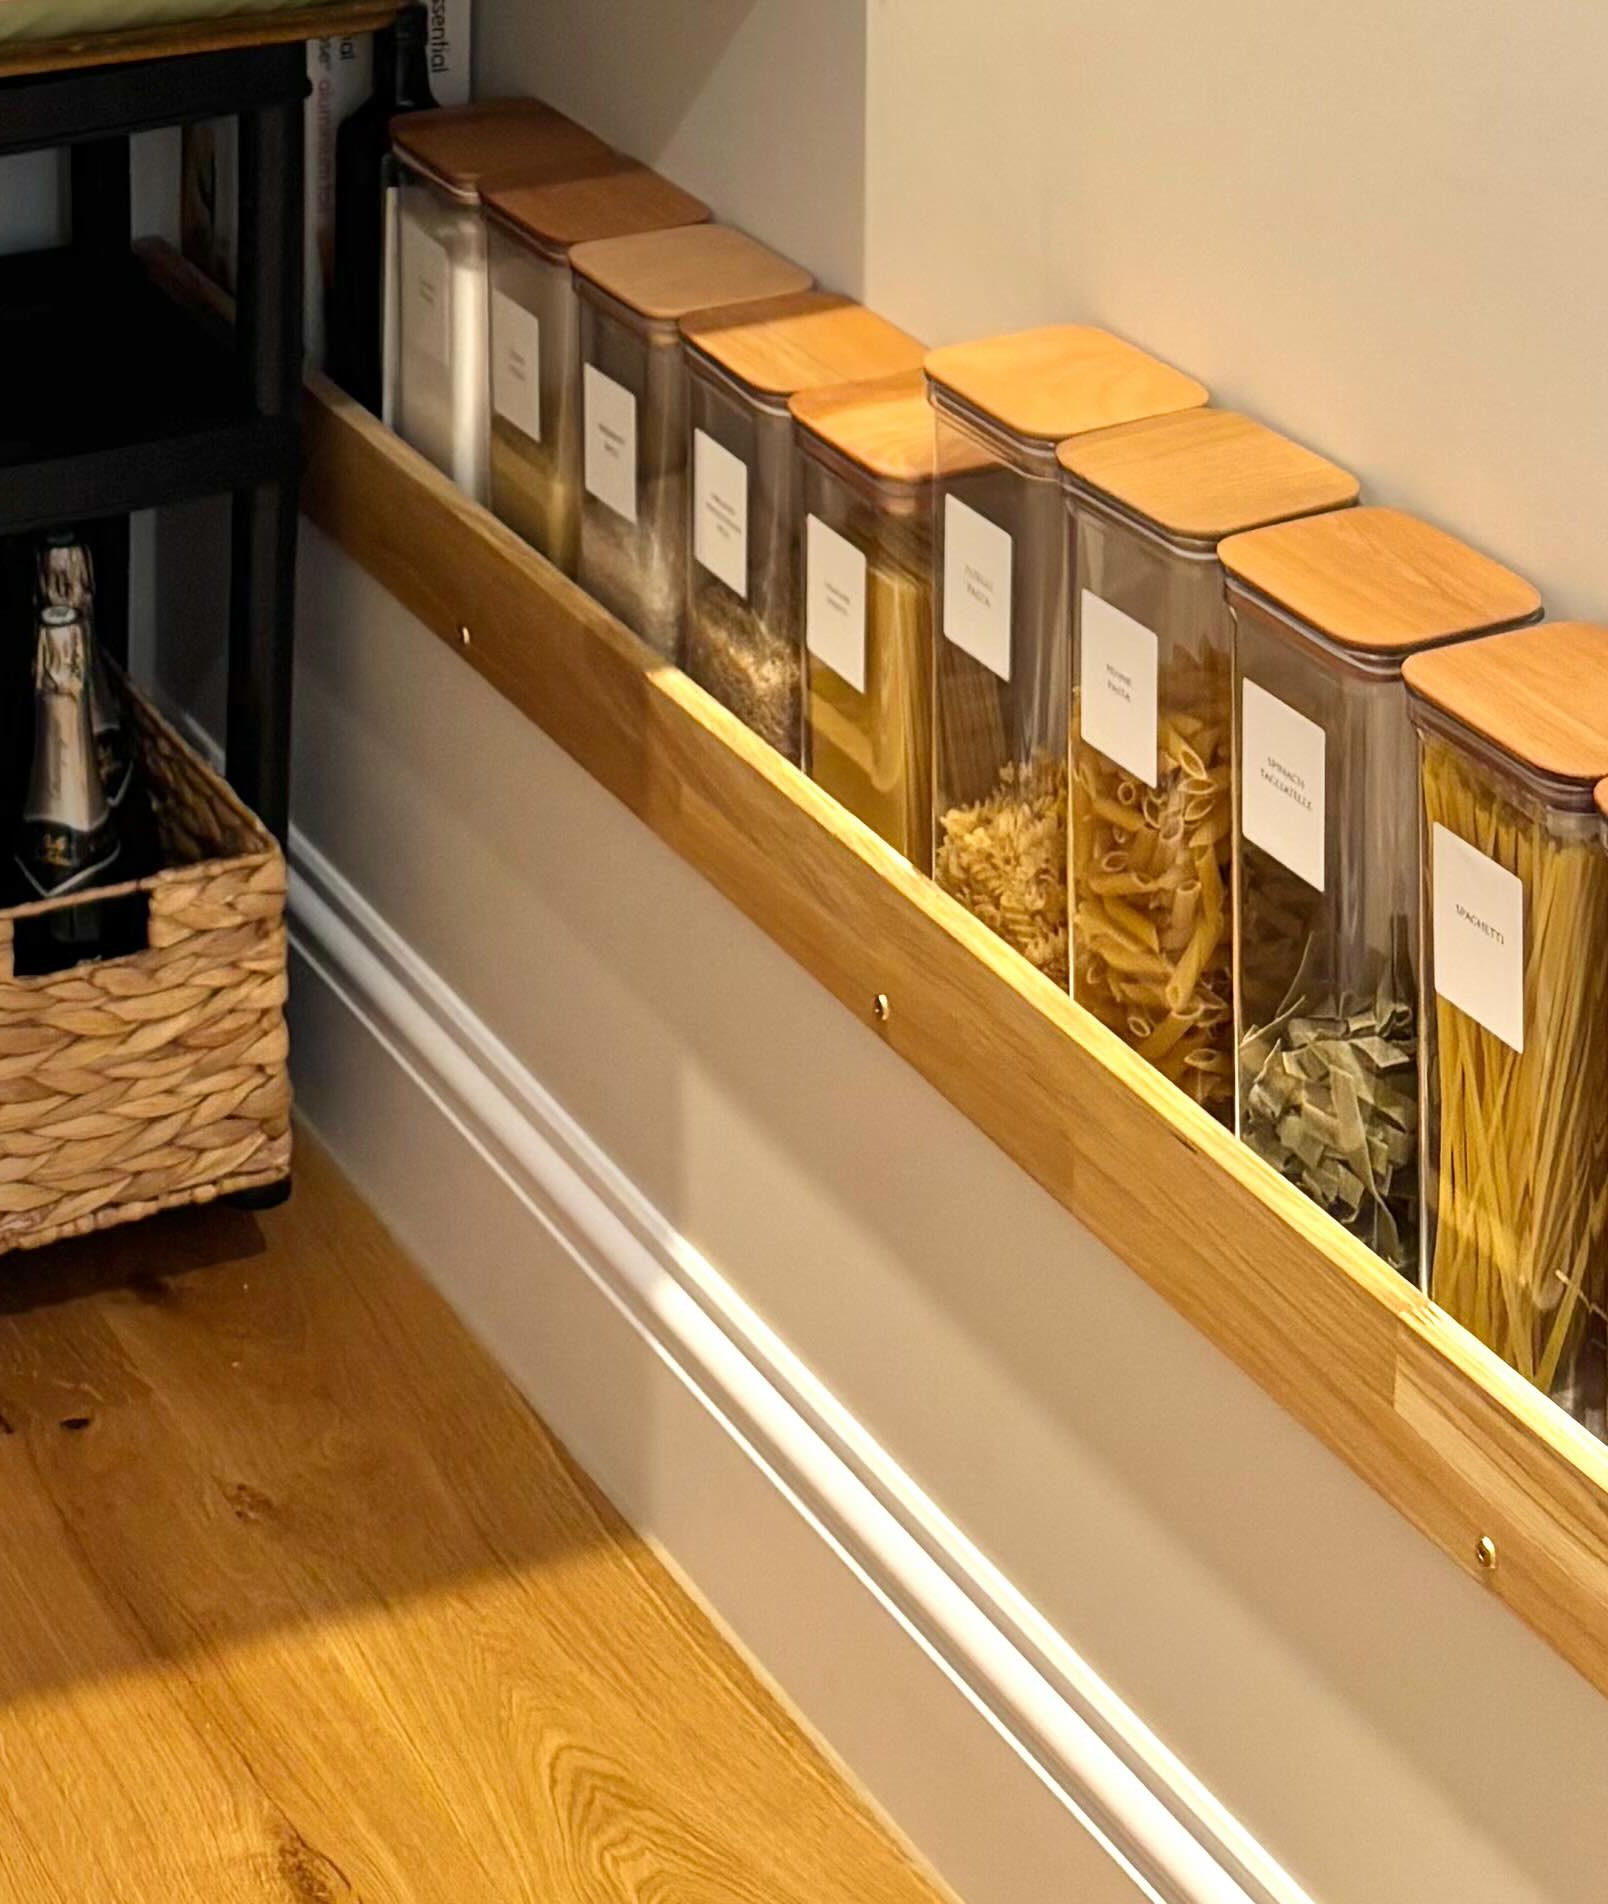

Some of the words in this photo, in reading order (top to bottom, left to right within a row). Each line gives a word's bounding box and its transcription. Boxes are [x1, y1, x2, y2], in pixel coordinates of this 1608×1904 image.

[1259, 767, 1313, 812] TAGLIATELLE
[1267, 756, 1305, 790] SPINACH
[1455, 903, 1505, 945] SPAGHETTI
